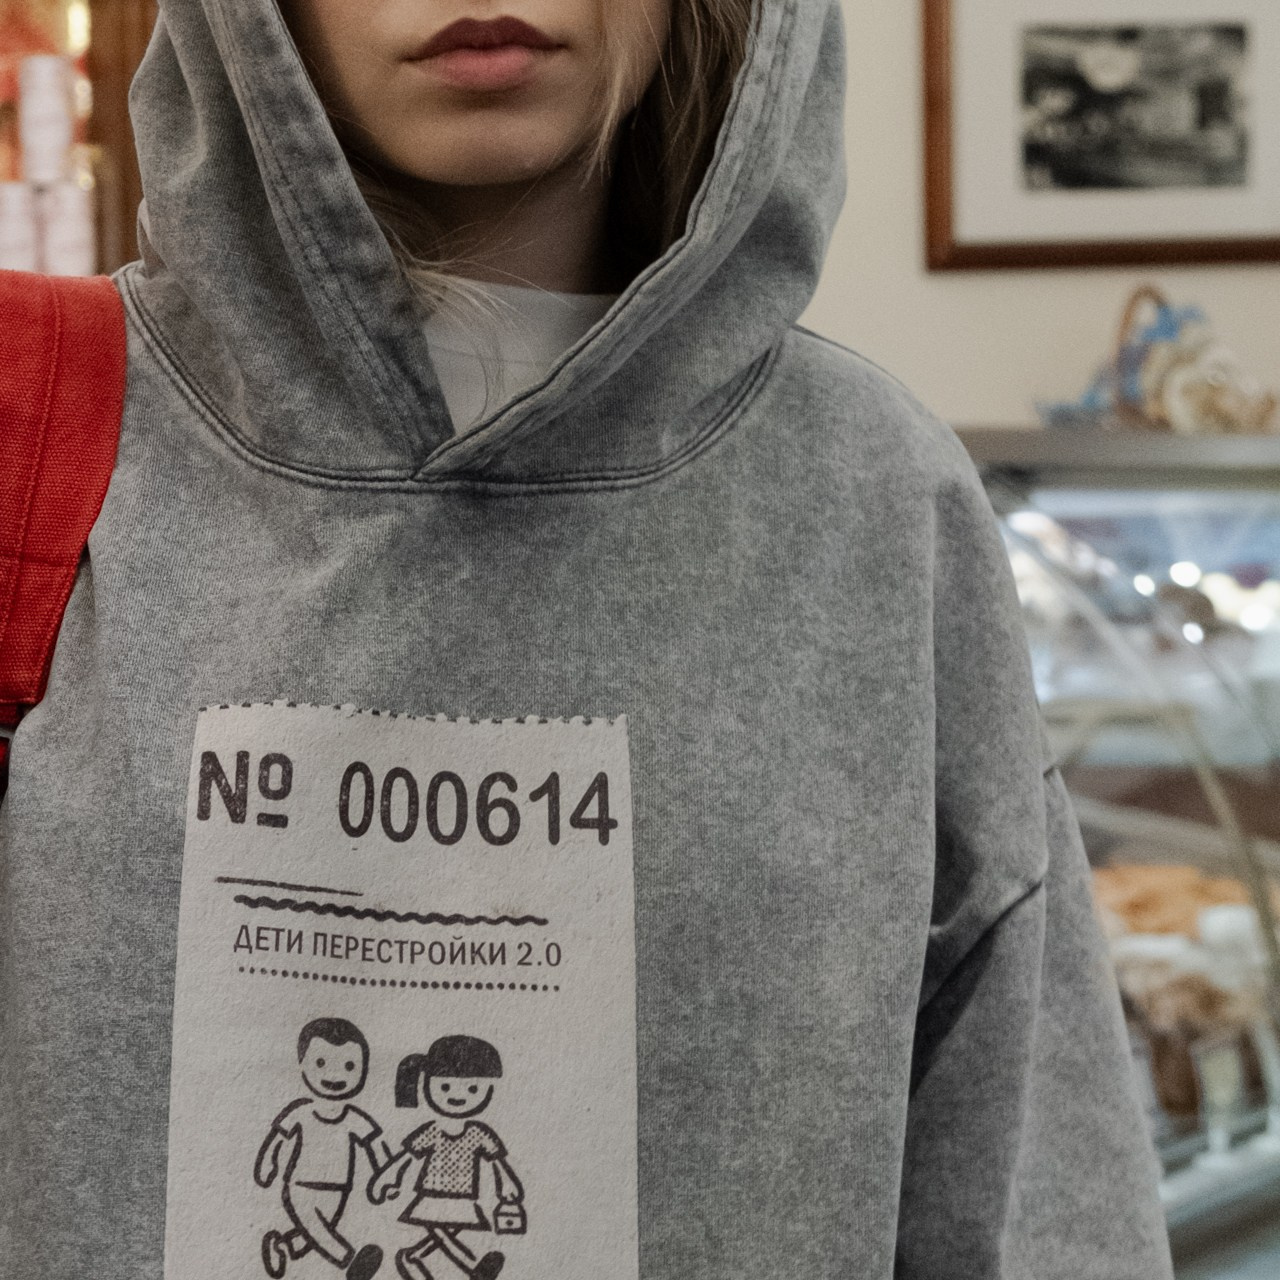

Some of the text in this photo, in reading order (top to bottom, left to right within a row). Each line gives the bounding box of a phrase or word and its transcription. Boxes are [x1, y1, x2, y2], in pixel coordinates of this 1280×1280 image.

[335, 760, 619, 847] 000614
[232, 923, 563, 968] ДЕТИ ПЕРЕСТРОЙКИ 2.0
